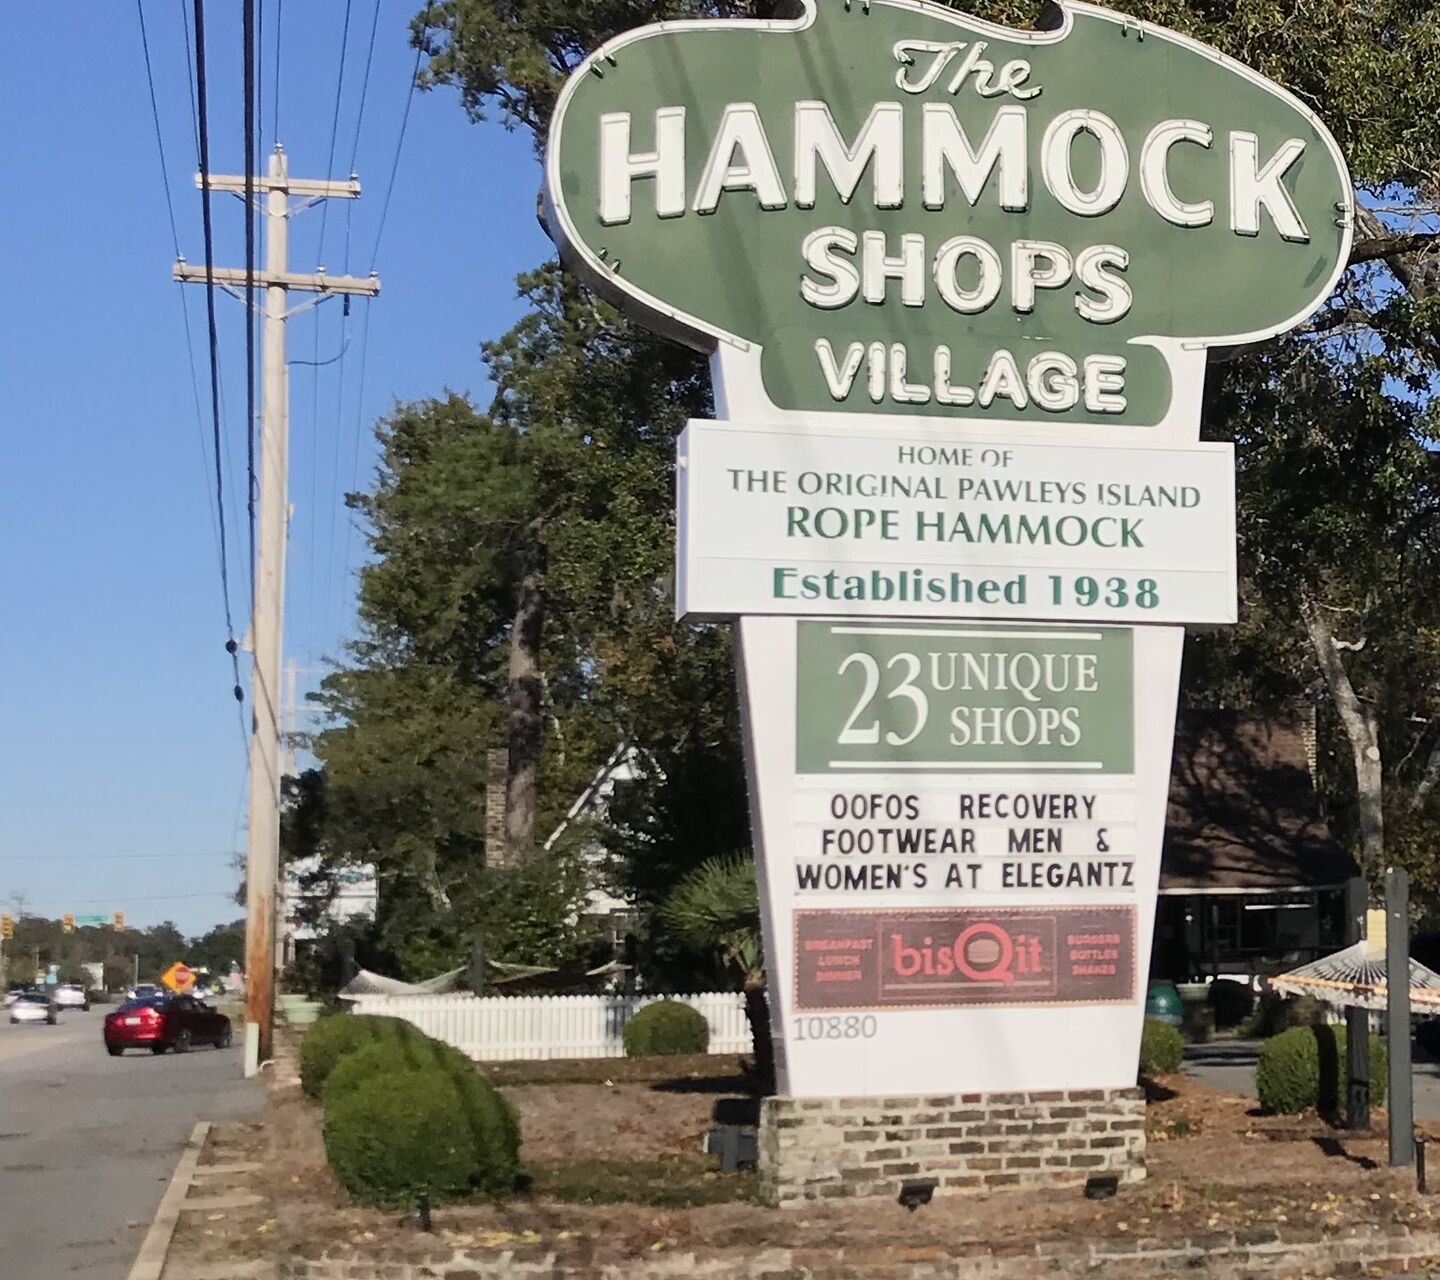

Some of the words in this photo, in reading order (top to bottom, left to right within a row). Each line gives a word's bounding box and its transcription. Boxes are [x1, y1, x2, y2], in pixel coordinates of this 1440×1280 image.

[893, 40, 1043, 100] The
[599, 101, 1310, 243] HAMMOCK
[801, 226, 1133, 324] SHOPS
[814, 338, 1128, 413] VILLAGE
[898, 445, 974, 468] HOME
[980, 449, 1014, 468] OF
[727, 469, 788, 495] THE
[797, 471, 948, 500] ORIGINAL
[958, 478, 1086, 505] PAWLEYS
[1097, 483, 1201, 508] ISLAND
[786, 506, 900, 541] ROPE
[916, 511, 1144, 548] HAMMOCK
[773, 567, 1026, 606] Established
[1048, 575, 1160, 609] 1938
[929, 652, 1099, 701] UNIQUE
[836, 651, 929, 748] 23
[950, 706, 1081, 748] SHOPS
[830, 794, 920, 820] OOFOS
[959, 794, 1097, 820] RECOVERY
[822, 828, 976, 855] FOOTWEAR
[1008, 828, 1062, 853] MEN
[1096, 828, 1110, 852] &
[796, 863, 928, 891] WOMEN'S
[945, 863, 983, 889] AT
[1002, 862, 1135, 889] ELEGANTZ
[891, 922, 1043, 985] bisQit
[793, 1015, 877, 1041] 10880
